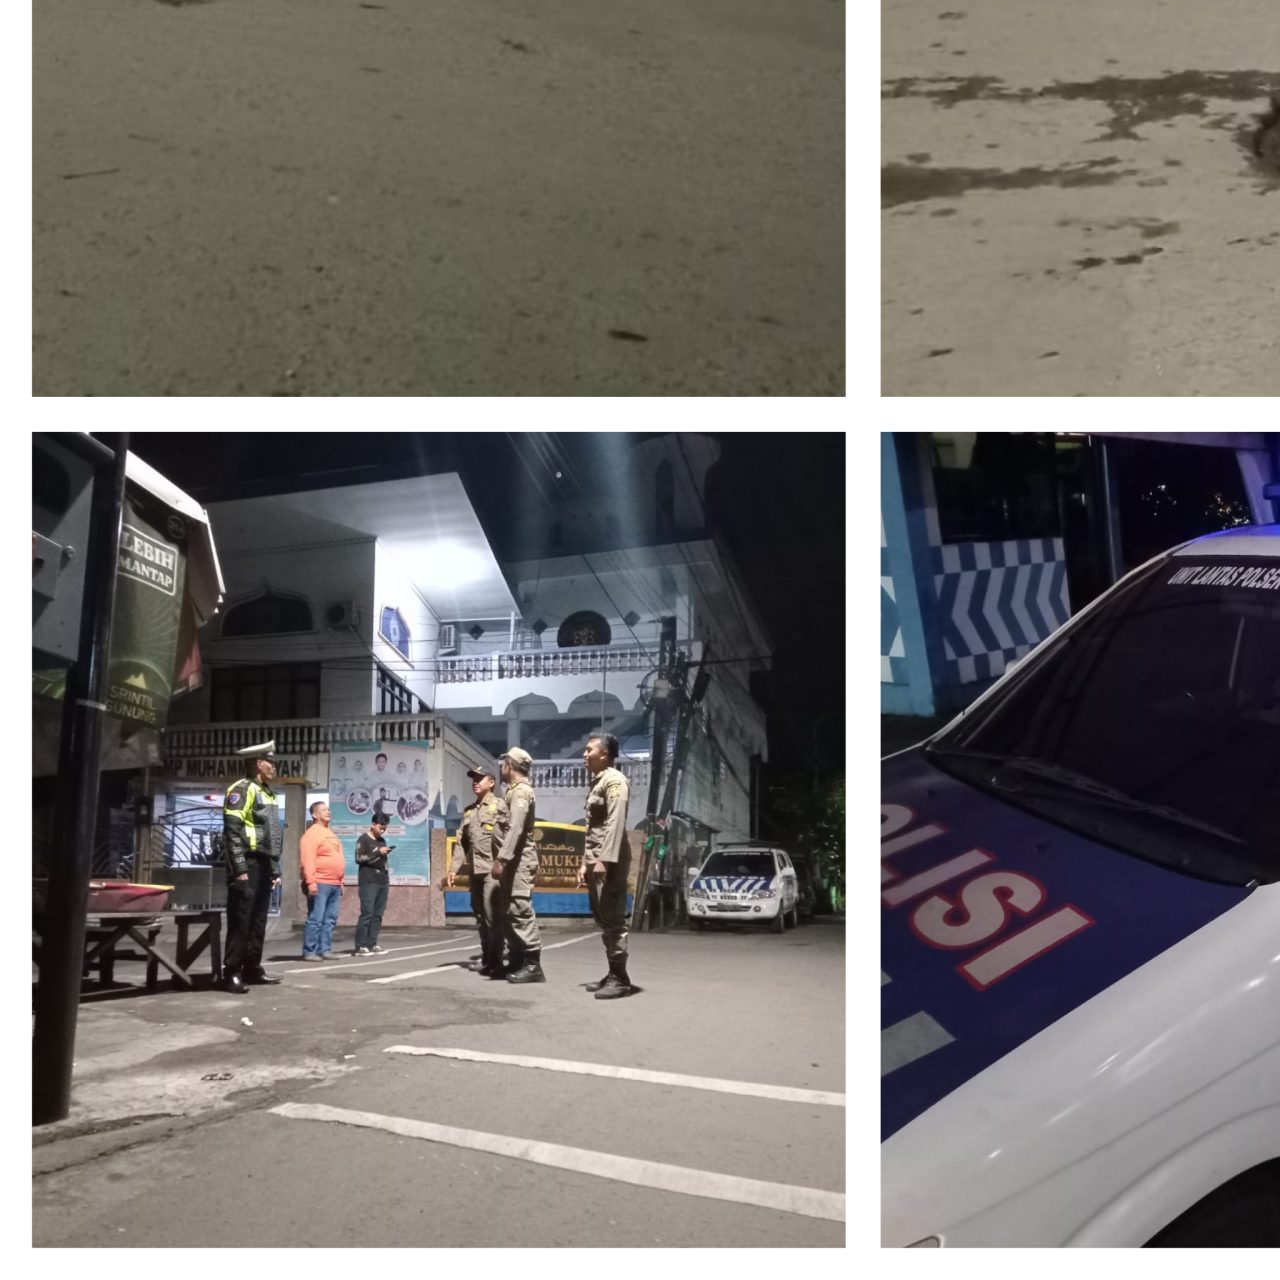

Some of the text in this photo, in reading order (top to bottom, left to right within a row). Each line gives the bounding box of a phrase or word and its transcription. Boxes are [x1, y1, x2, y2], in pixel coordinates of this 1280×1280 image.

[120, 531, 174, 571] LEBIH
[118, 555, 173, 588] MANTAP
[1167, 566, 1196, 585] UNIT
[1192, 566, 1243, 586] LANTAS
[104, 699, 157, 725] GUNUNG
[186, 757, 301, 779] MUHAMMYAH
[881, 802, 1096, 993] LISI
